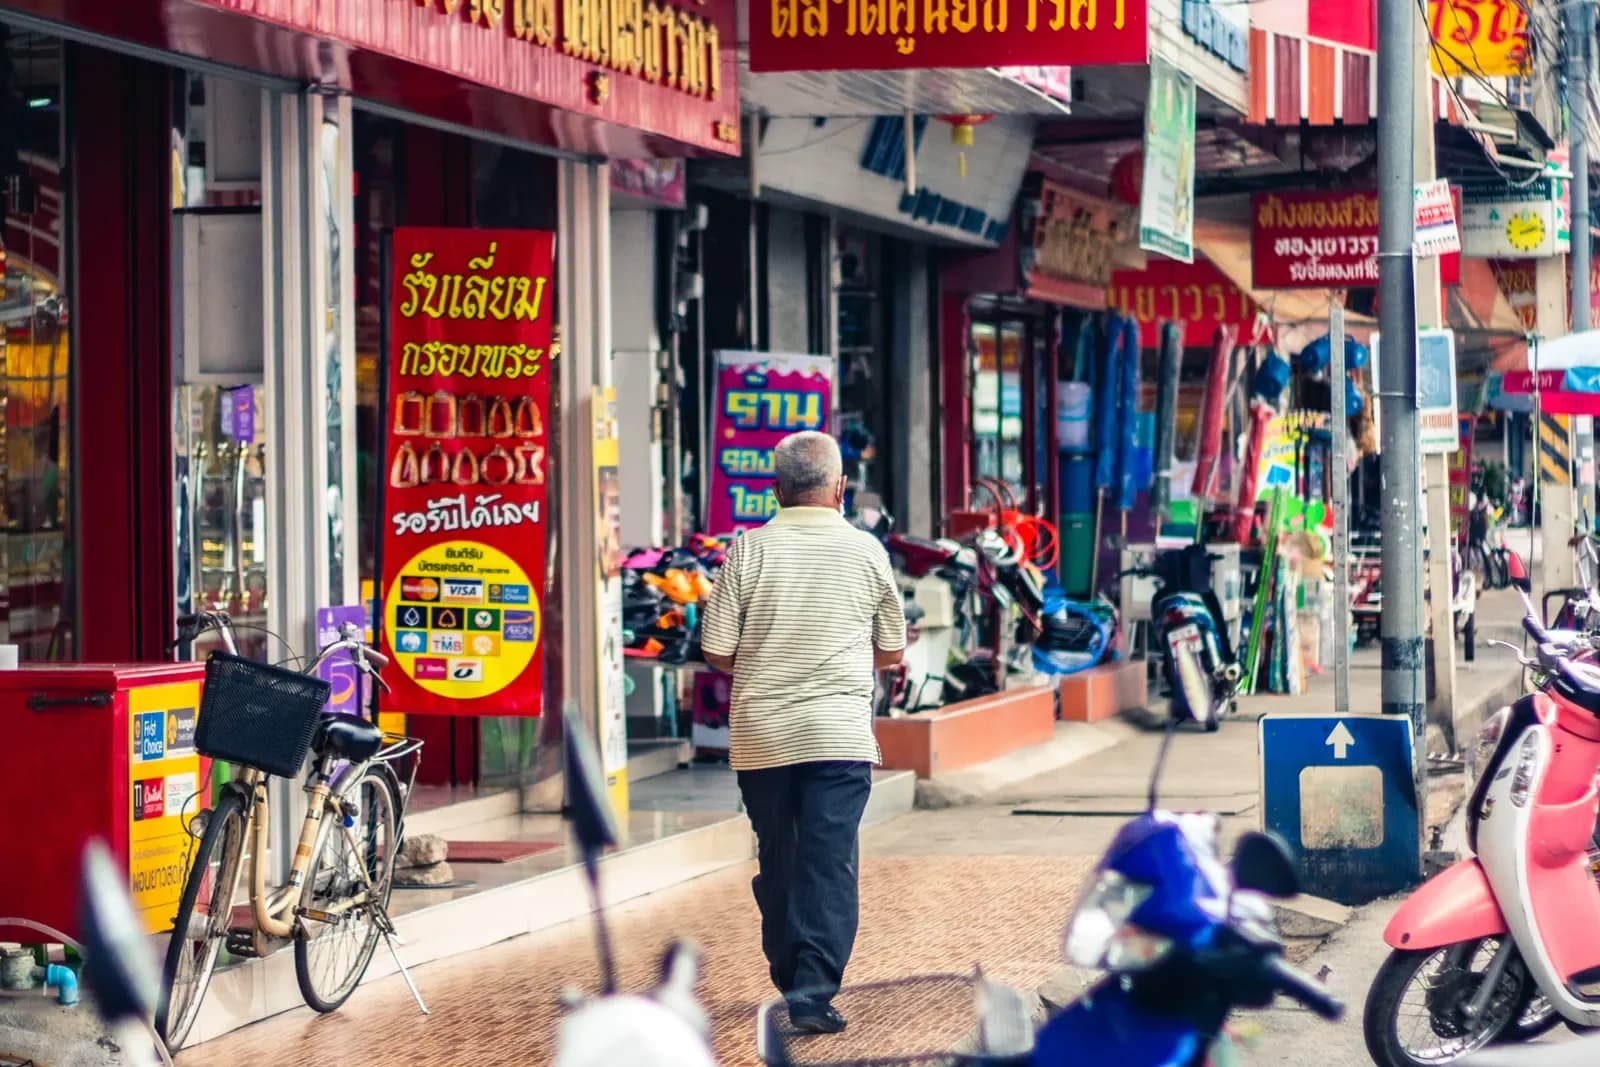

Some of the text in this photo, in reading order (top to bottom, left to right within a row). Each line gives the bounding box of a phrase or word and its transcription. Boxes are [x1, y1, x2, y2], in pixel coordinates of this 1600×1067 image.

[1274, 236, 1379, 256] ทองเยาวรา
[400, 242, 547, 320] รับเลี่ยม
[400, 341, 543, 378] กรอบพระ
[727, 373, 820, 428] ร้าน
[722, 449, 777, 474] รอง
[392, 493, 540, 535] รอรับได้เลย
[449, 586, 477, 596] VISA
[432, 637, 463, 650] TMB
